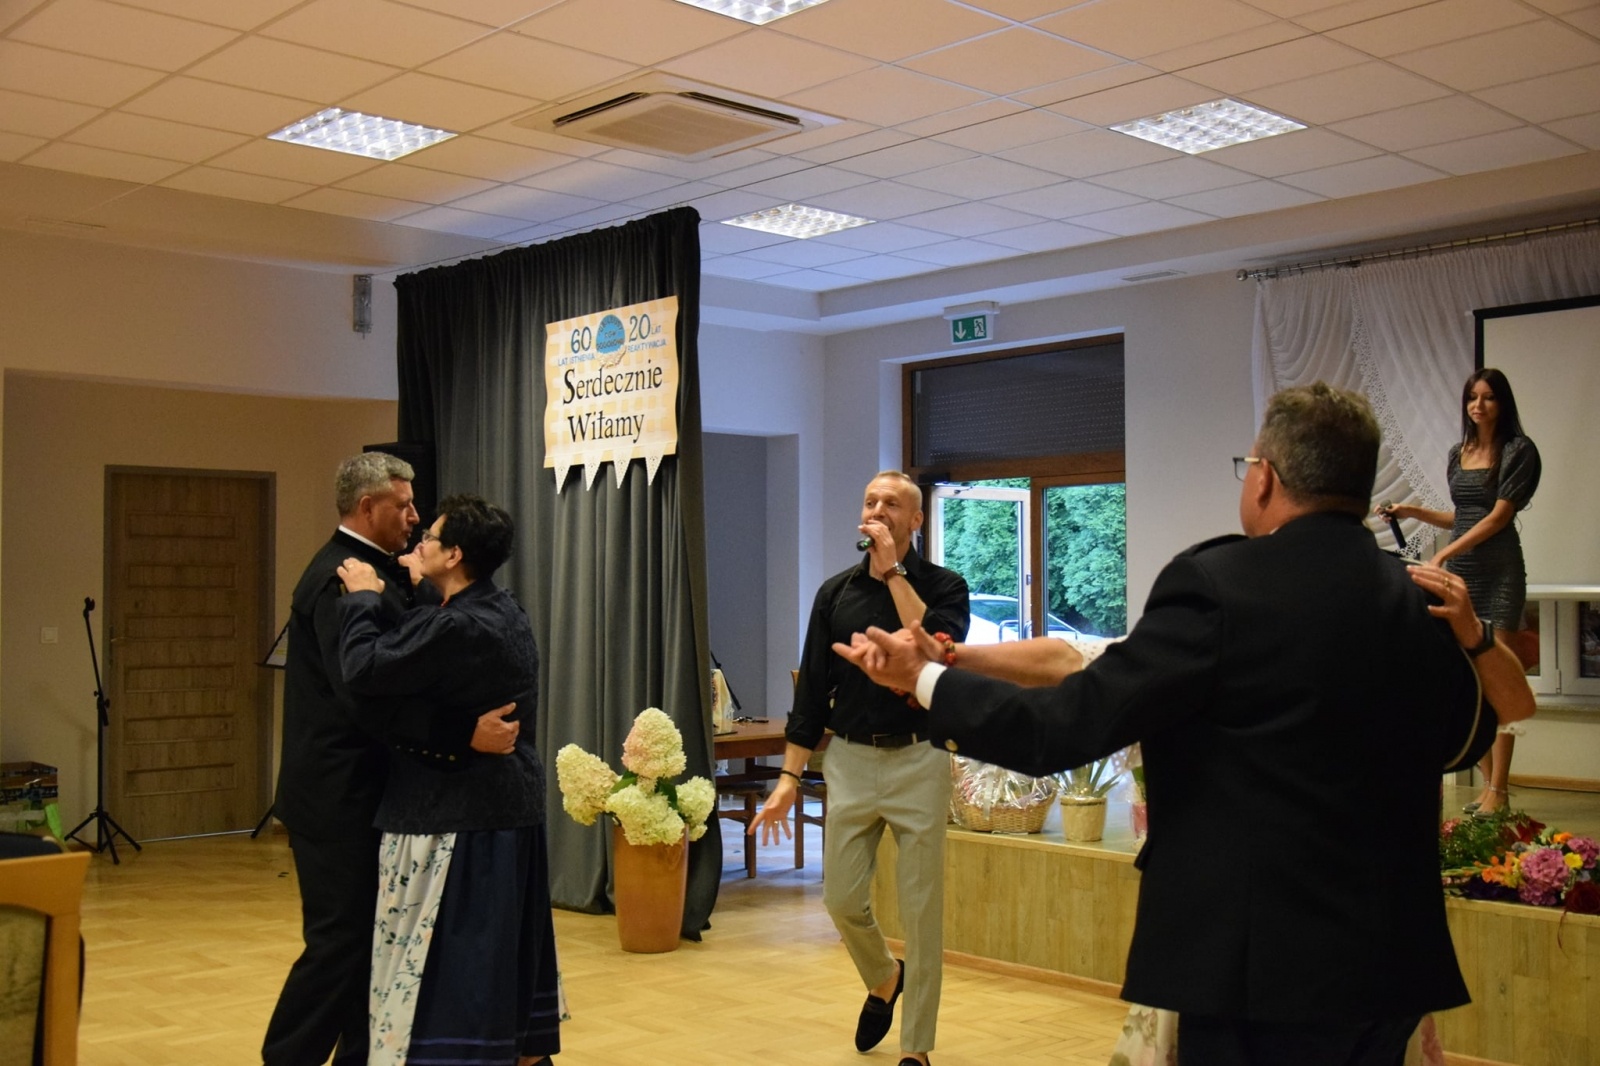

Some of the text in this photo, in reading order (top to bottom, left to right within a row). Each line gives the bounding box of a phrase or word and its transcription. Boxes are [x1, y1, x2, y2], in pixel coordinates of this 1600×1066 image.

[571, 326, 592, 354] 60
[628, 313, 651, 342] 20
[563, 358, 663, 405] Serdecznie
